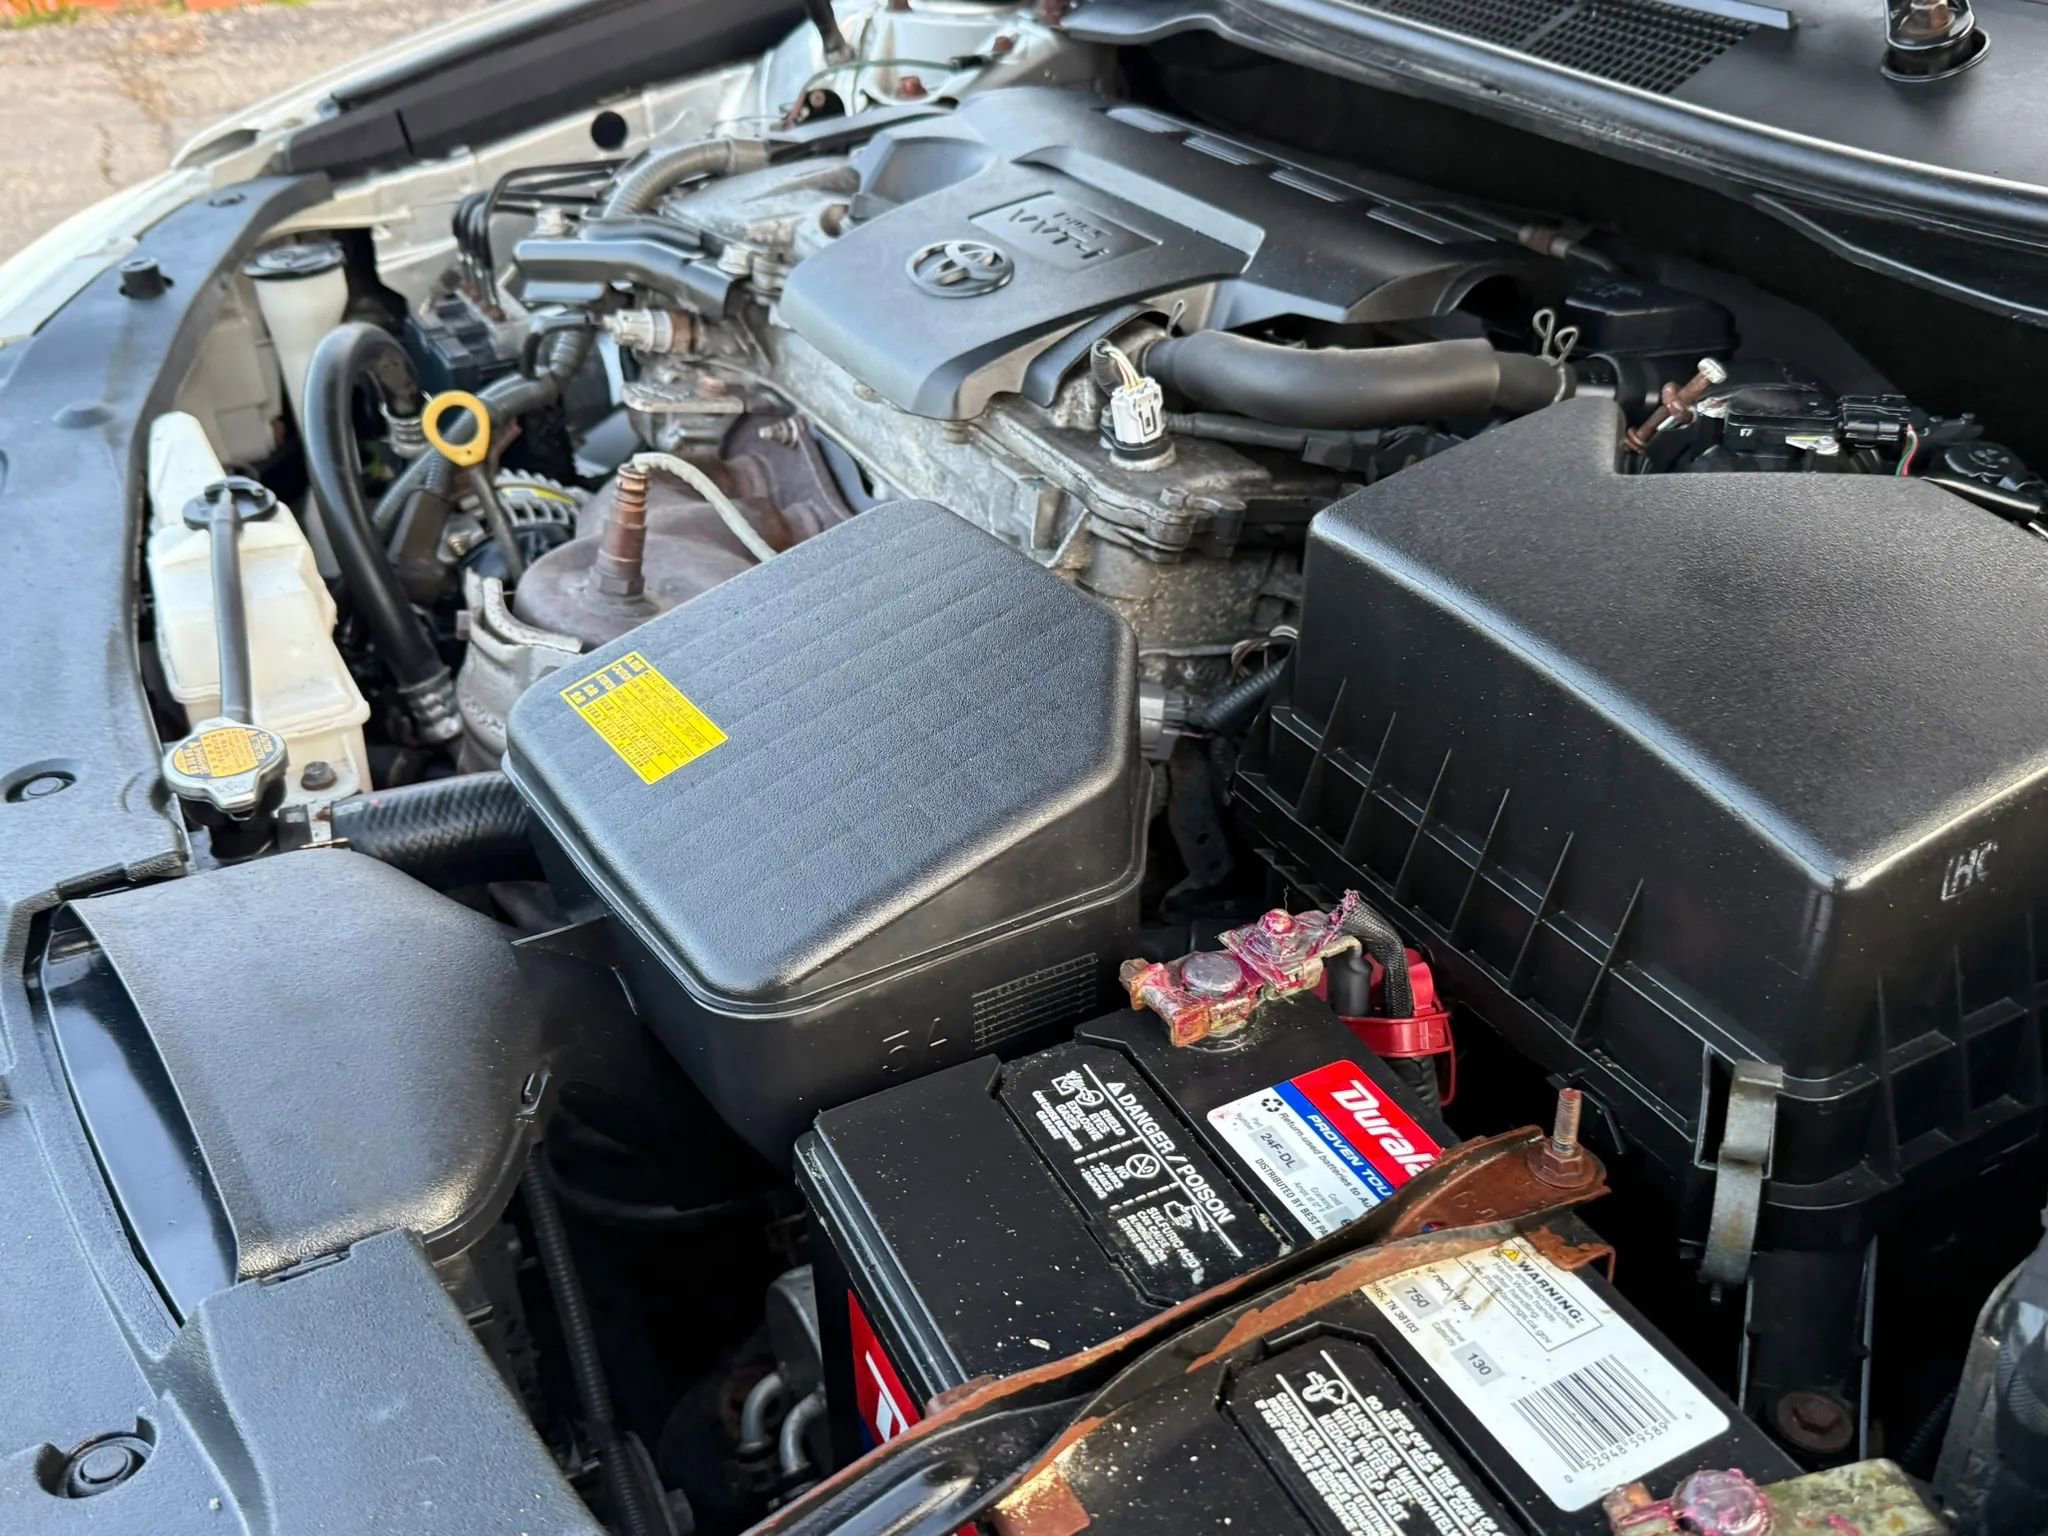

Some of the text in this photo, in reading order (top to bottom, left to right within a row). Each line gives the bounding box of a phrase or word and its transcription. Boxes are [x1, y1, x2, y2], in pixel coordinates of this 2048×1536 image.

[1056, 1104, 1080, 1130] GASES
[1065, 1100, 1103, 1141] EXPLOSIVE
[1100, 1109, 1126, 1135] SHIELD
[1260, 1134, 1295, 1168] 24F-DL
[1308, 1115, 1364, 1166] PROVEN
[1114, 1166, 1131, 1179] NO
[1256, 1159, 1295, 1198] DISTRIBUTED
[1292, 1198, 1304, 1207] BY
[1300, 1208, 1320, 1224] BEST
[1317, 1154, 1353, 1186] batteries
[1349, 1187, 1361, 1195] to
[1137, 1211, 1170, 1248] CAN CAUSE
[1147, 1207, 1200, 1268] SULFURIC ACID
[1406, 1287, 1430, 1307] 750
[1518, 1260, 1585, 1323] WARNING:
[1385, 1300, 1398, 1310] TN
[1394, 1311, 1419, 1333] 38103
[1468, 1354, 1491, 1375] 130
[1262, 1410, 1281, 1428] NOT
[1304, 1430, 1323, 1448] FOR
[1343, 1403, 1378, 1437] FLUSH
[1372, 1438, 1401, 1467] EYES
[1332, 1408, 1360, 1438] WITH
[1386, 1479, 1412, 1502] GET
[1366, 1396, 1382, 1410] DO
[1378, 1411, 1398, 1429] NOT
[1409, 1448, 1433, 1472] KEEP
[1430, 1472, 1454, 1496] VENT
[1390, 1409, 1414, 1431] KEEP
[1408, 1432, 1431, 1451] OUT
[1438, 1466, 1459, 1487] THE
[1453, 1486, 1484, 1518] REACH
[1585, 1444, 1627, 1470] 52948
[1628, 1421, 1668, 1446] 59589
[1318, 1414, 1409, 1520] MEDICAL HELP FAST
